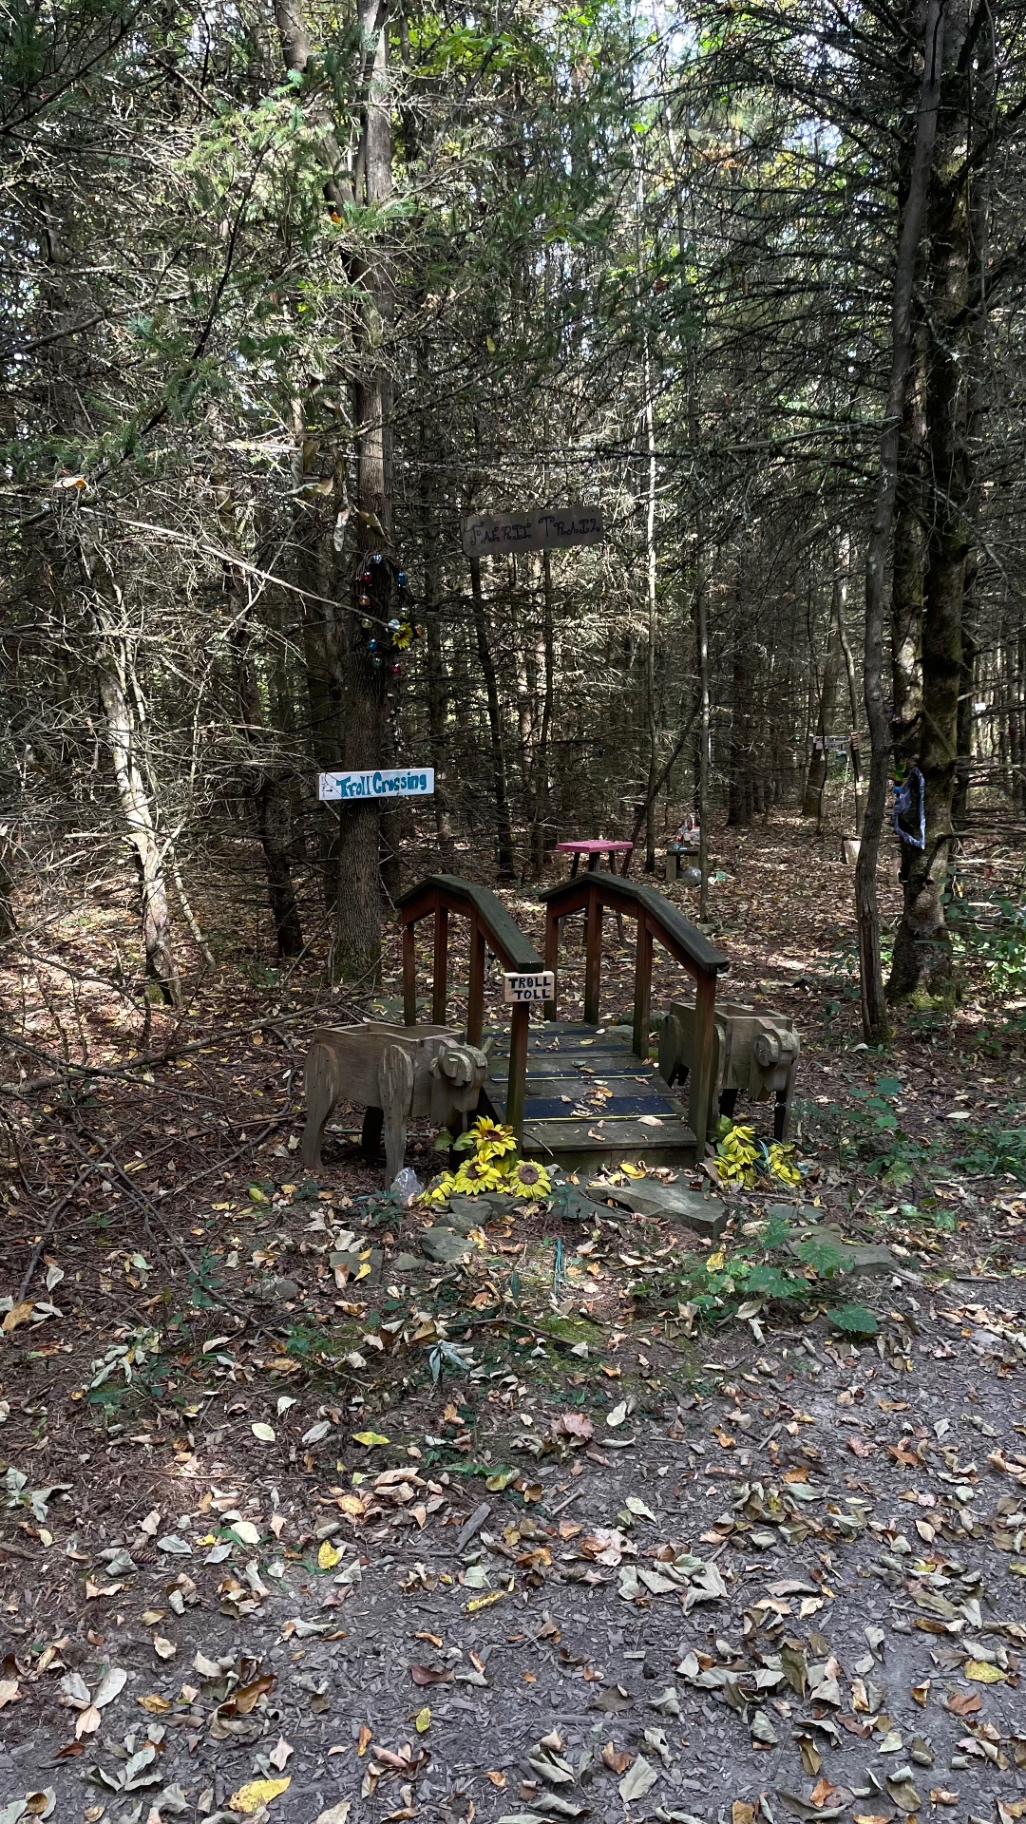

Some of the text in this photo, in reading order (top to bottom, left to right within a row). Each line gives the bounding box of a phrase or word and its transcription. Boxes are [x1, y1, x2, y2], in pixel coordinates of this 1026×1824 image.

[336, 776, 372, 797] Troll
[372, 771, 427, 794] Crossing
[508, 976, 551, 988] TROLL
[514, 989, 550, 1000] TOLL
